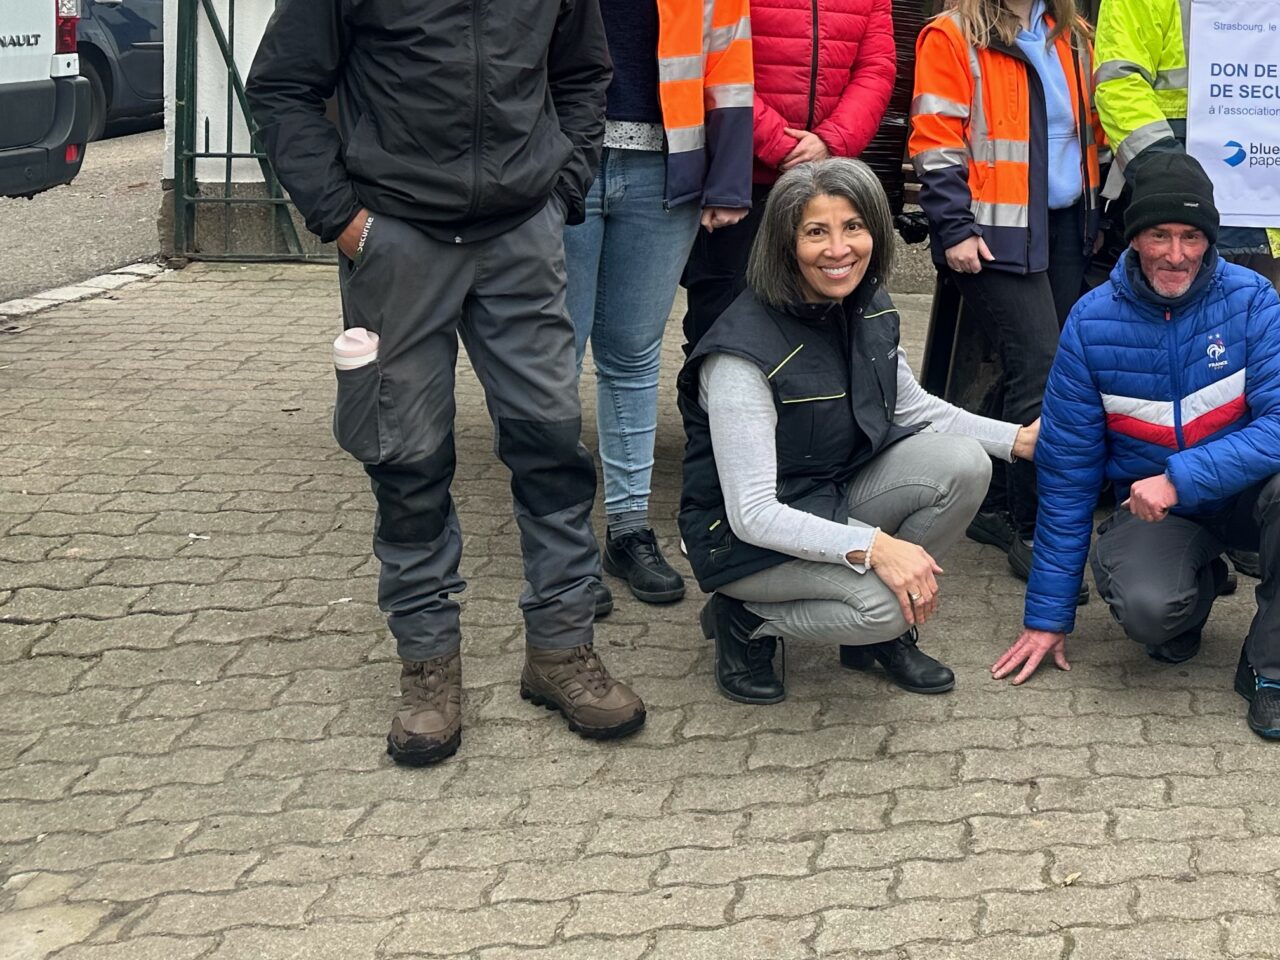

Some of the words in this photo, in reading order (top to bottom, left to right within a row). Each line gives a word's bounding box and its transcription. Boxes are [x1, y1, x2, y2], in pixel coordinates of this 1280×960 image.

[1268, 23, 1277, 32] le
[1210, 63, 1249, 77] DON
[1254, 64, 1278, 78] DE
[1210, 83, 1233, 98] DE
[1249, 142, 1280, 155] blue
